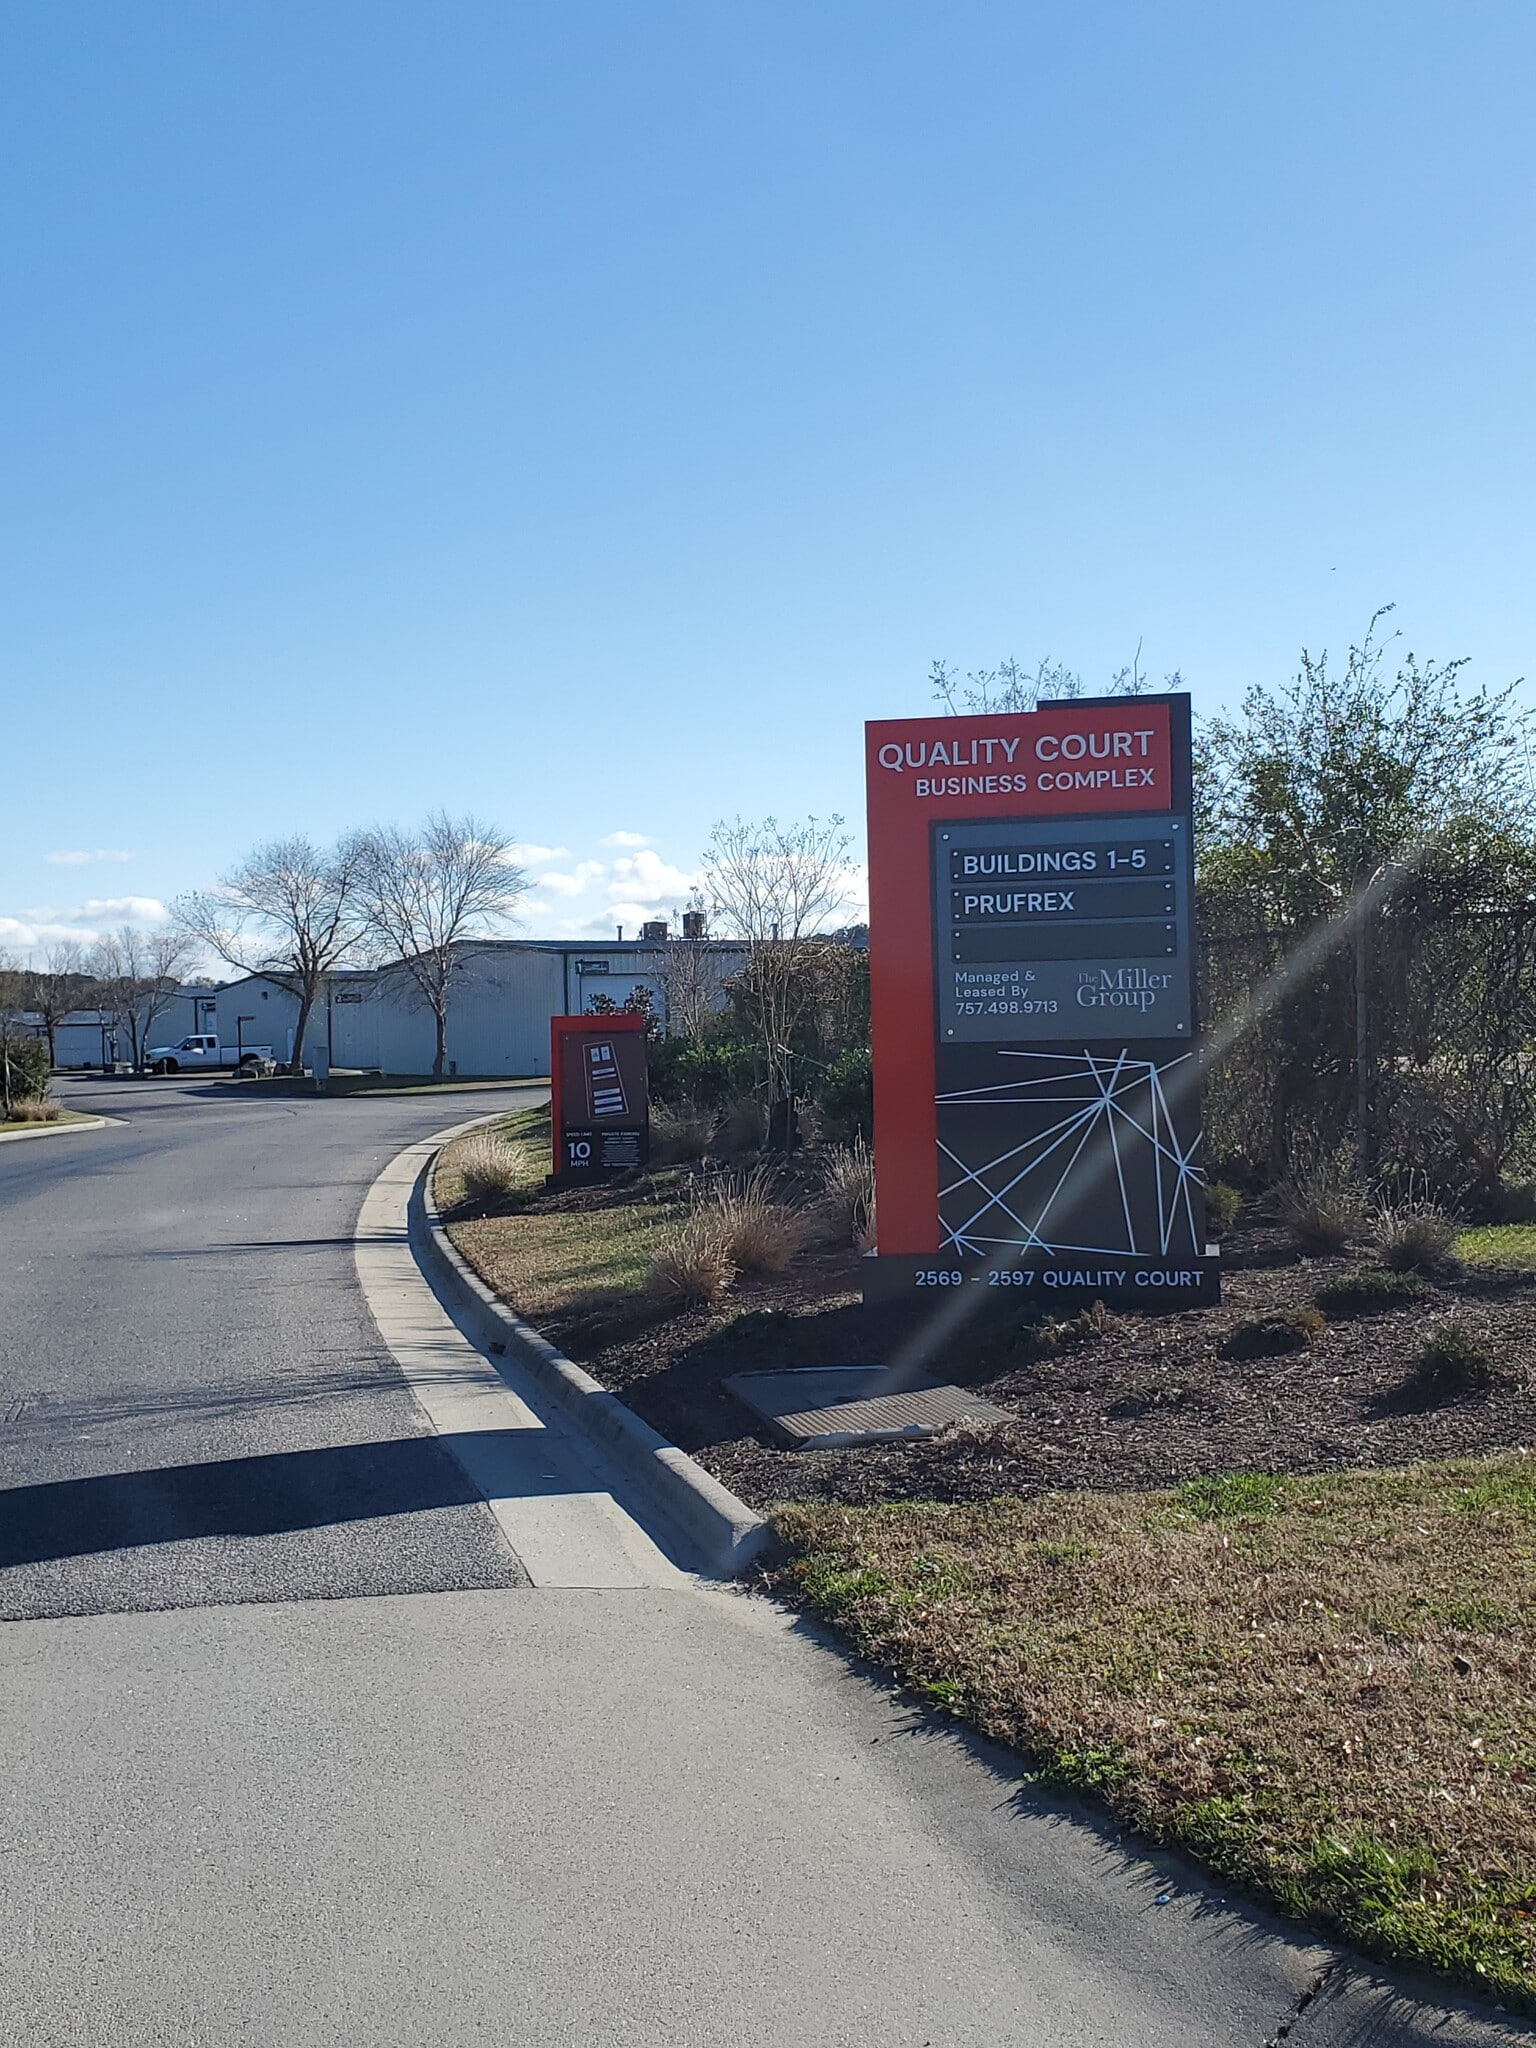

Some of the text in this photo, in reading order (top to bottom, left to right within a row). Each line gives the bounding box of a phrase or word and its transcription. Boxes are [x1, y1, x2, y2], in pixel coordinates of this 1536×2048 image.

[878, 730, 1155, 772] QUALITY COURT
[915, 768, 1156, 797] BUSINESS COMPLEX
[963, 849, 1147, 875] BUILDINGS 1-5
[964, 891, 1075, 914] PRUFREX
[955, 970, 1036, 984] Managed &
[1077, 968, 1172, 990] The Miller
[955, 985, 1029, 999] Leased By
[1076, 984, 1156, 1012] Group
[955, 1000, 1058, 1015] 757.498.9713
[568, 1142, 591, 1158] 10
[915, 1271, 963, 1287] 2569
[988, 1271, 1035, 1287] 2597
[1043, 1271, 1127, 1289] QUALITY
[1134, 1271, 1204, 1287] COURT
